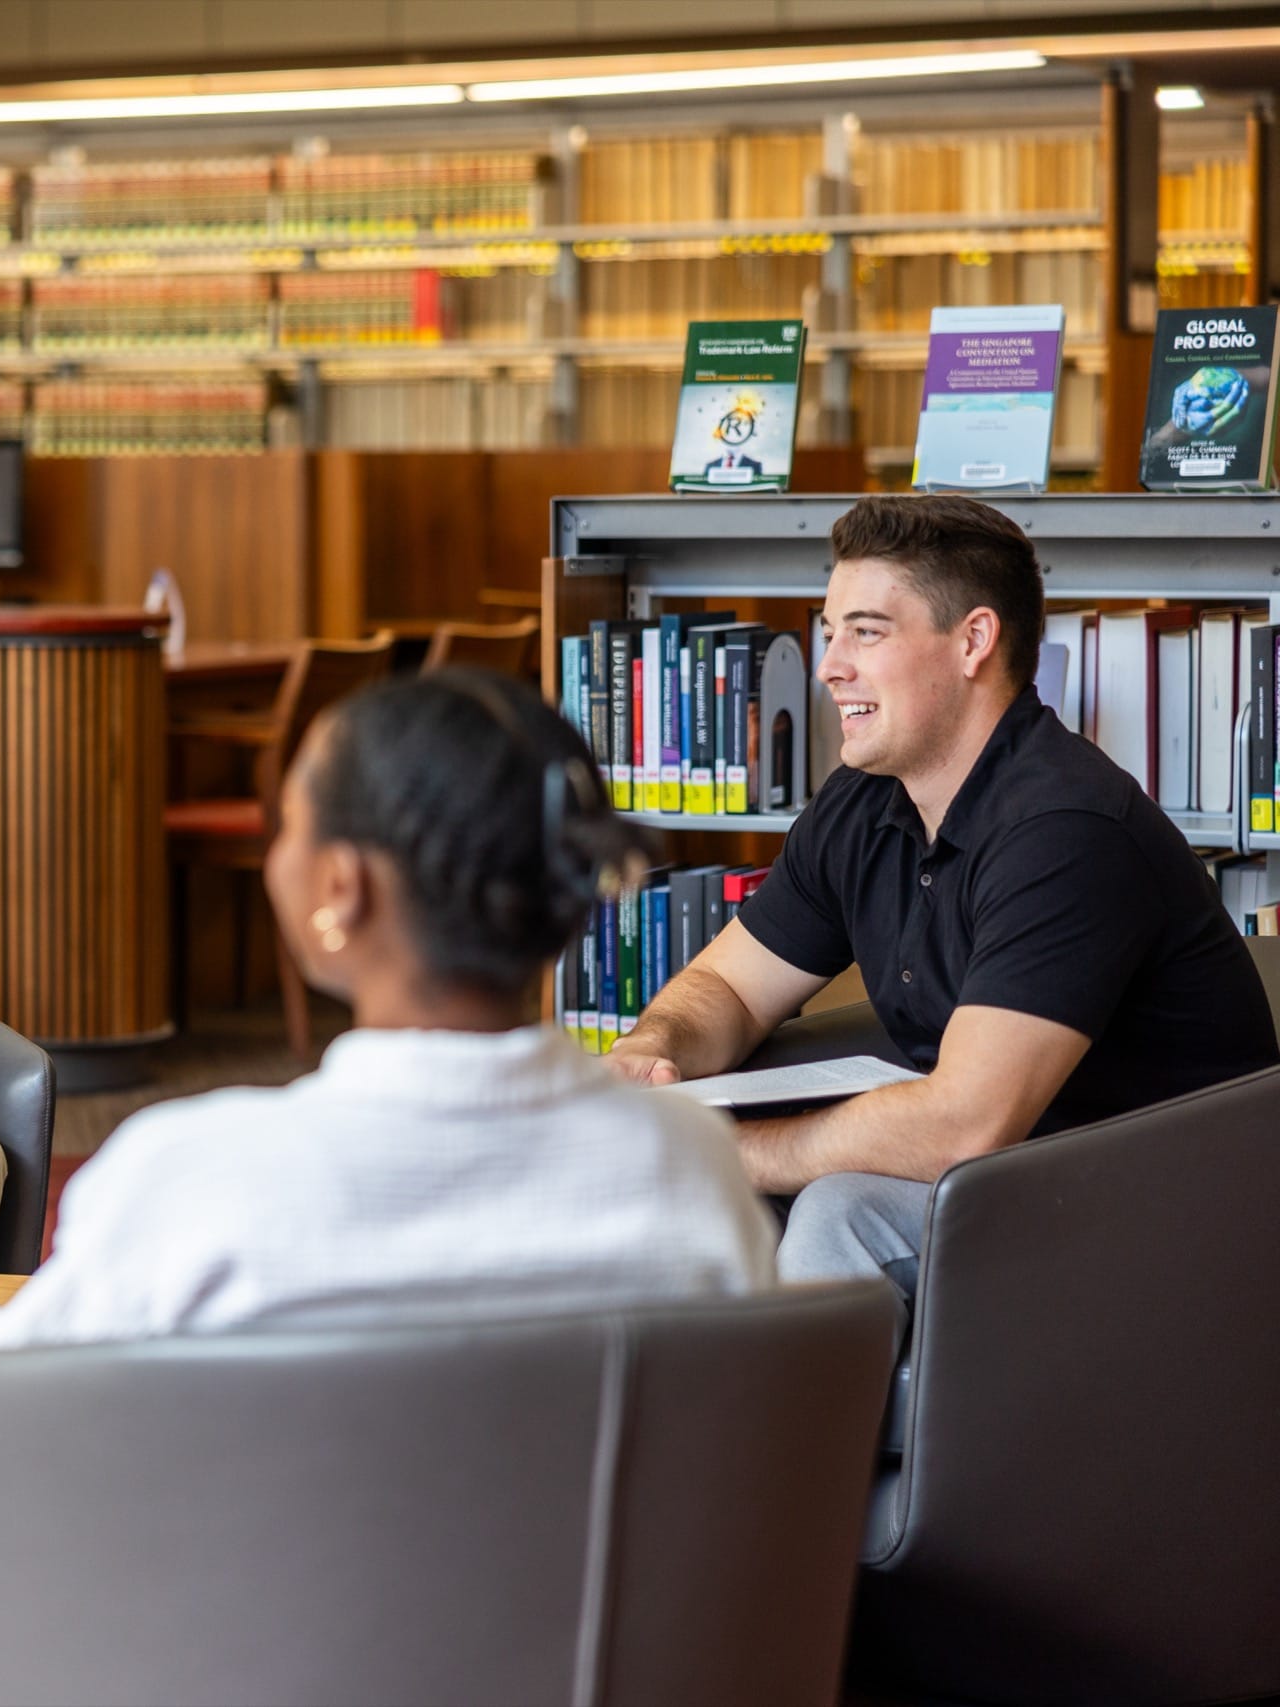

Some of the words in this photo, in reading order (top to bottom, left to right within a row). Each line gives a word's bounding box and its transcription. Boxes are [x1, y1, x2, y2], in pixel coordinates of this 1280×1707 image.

[1186, 319, 1246, 334] GLOBAL
[961, 338, 979, 347] THE
[981, 337, 1033, 347] SINGAPORE
[1174, 334, 1206, 349] PRO
[1209, 333, 1256, 348] BONO
[699, 346, 742, 355] Trademark
[743, 344, 760, 355] Law
[762, 343, 793, 354] Reform
[955, 348, 1019, 357] CONVENTION
[1020, 347, 1035, 356] ON
[968, 357, 1021, 367] MEDIATION
[613, 652, 625, 714] DUPED
[694, 661, 706, 720] Comparative
